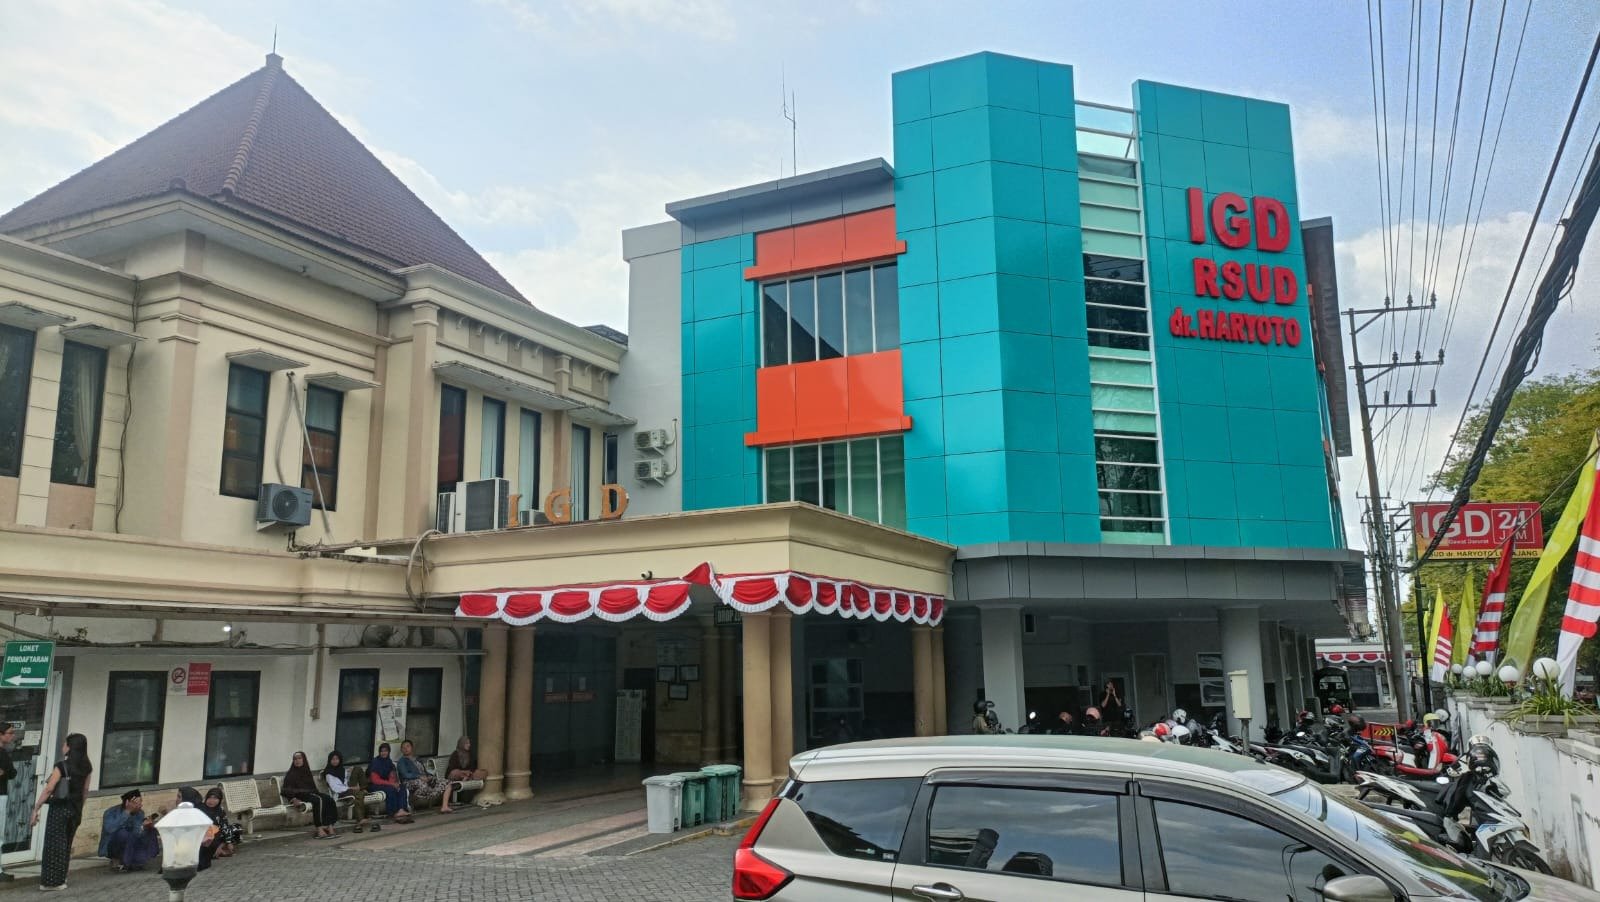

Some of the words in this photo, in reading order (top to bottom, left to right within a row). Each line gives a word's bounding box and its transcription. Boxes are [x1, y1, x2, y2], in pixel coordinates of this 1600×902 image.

[1187, 188, 1291, 252] IGD
[1193, 257, 1298, 305] RSUD
[1170, 307, 1197, 337] dr.
[1197, 309, 1302, 347] HARYOTO
[1421, 510, 1491, 539] IGD
[1498, 511, 1528, 530] 24
[1499, 530, 1527, 540] JM
[6, 655, 49, 663] PENDAFTARAN
